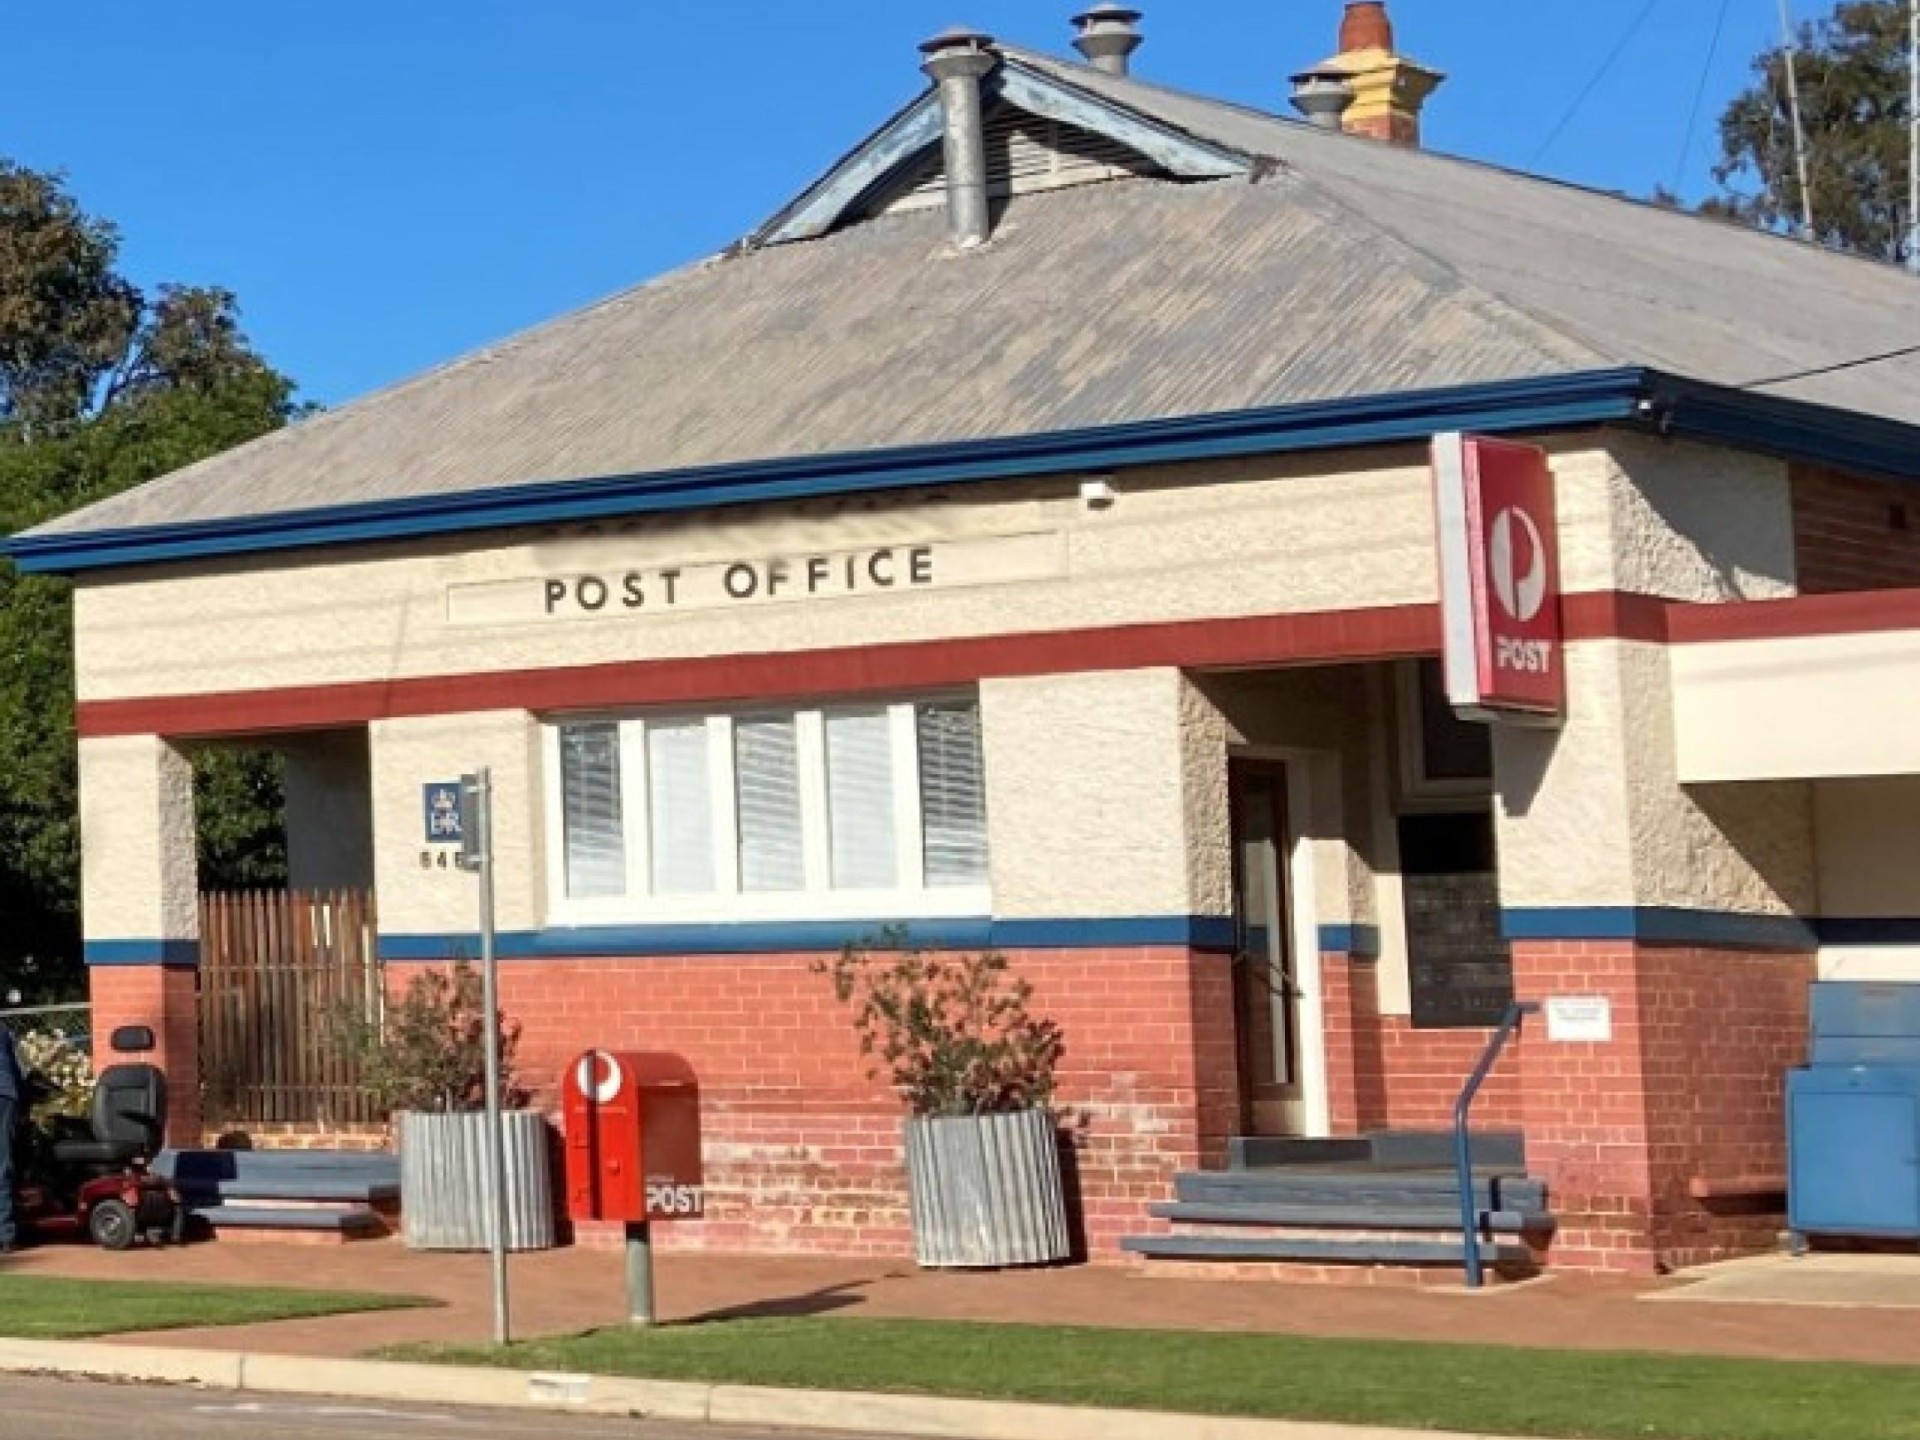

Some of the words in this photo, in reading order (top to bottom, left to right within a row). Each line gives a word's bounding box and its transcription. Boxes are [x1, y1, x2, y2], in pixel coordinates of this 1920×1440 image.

[543, 569, 681, 614] POST
[723, 547, 932, 598] OFFICE
[1496, 635, 1551, 673] POST
[646, 1183, 703, 1213] POST
